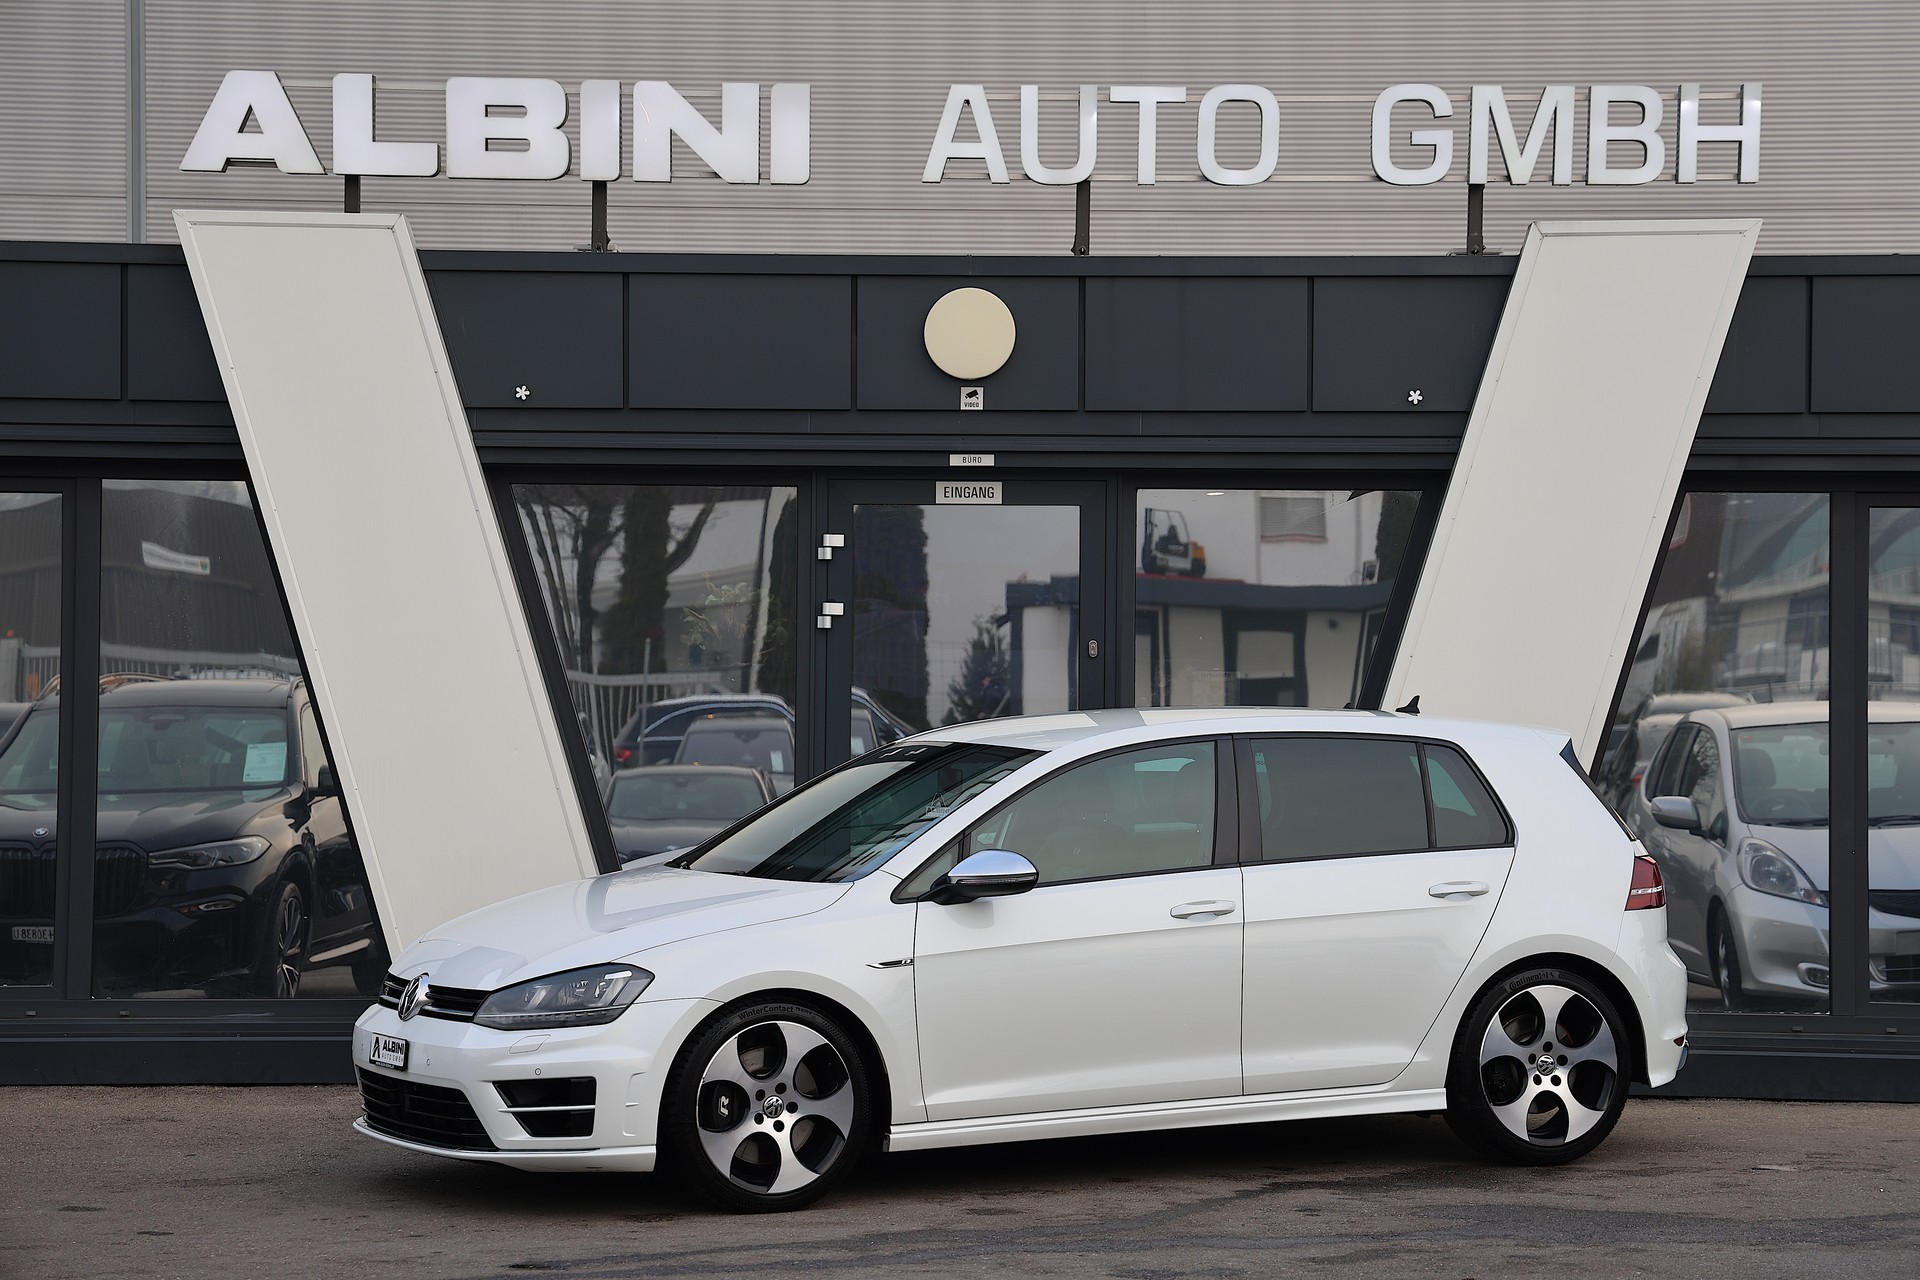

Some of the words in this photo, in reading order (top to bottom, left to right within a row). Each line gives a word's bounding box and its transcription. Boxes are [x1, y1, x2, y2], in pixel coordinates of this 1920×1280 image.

[180, 69, 812, 186] ALBINI
[921, 83, 1281, 186] AUTO
[1370, 83, 1763, 186] GMBH
[962, 455, 982, 464] BÜRO
[943, 486, 995, 499] EINGANG
[738, 1005, 794, 1020] WinterContact
[382, 1040, 404, 1055] ALBINI
